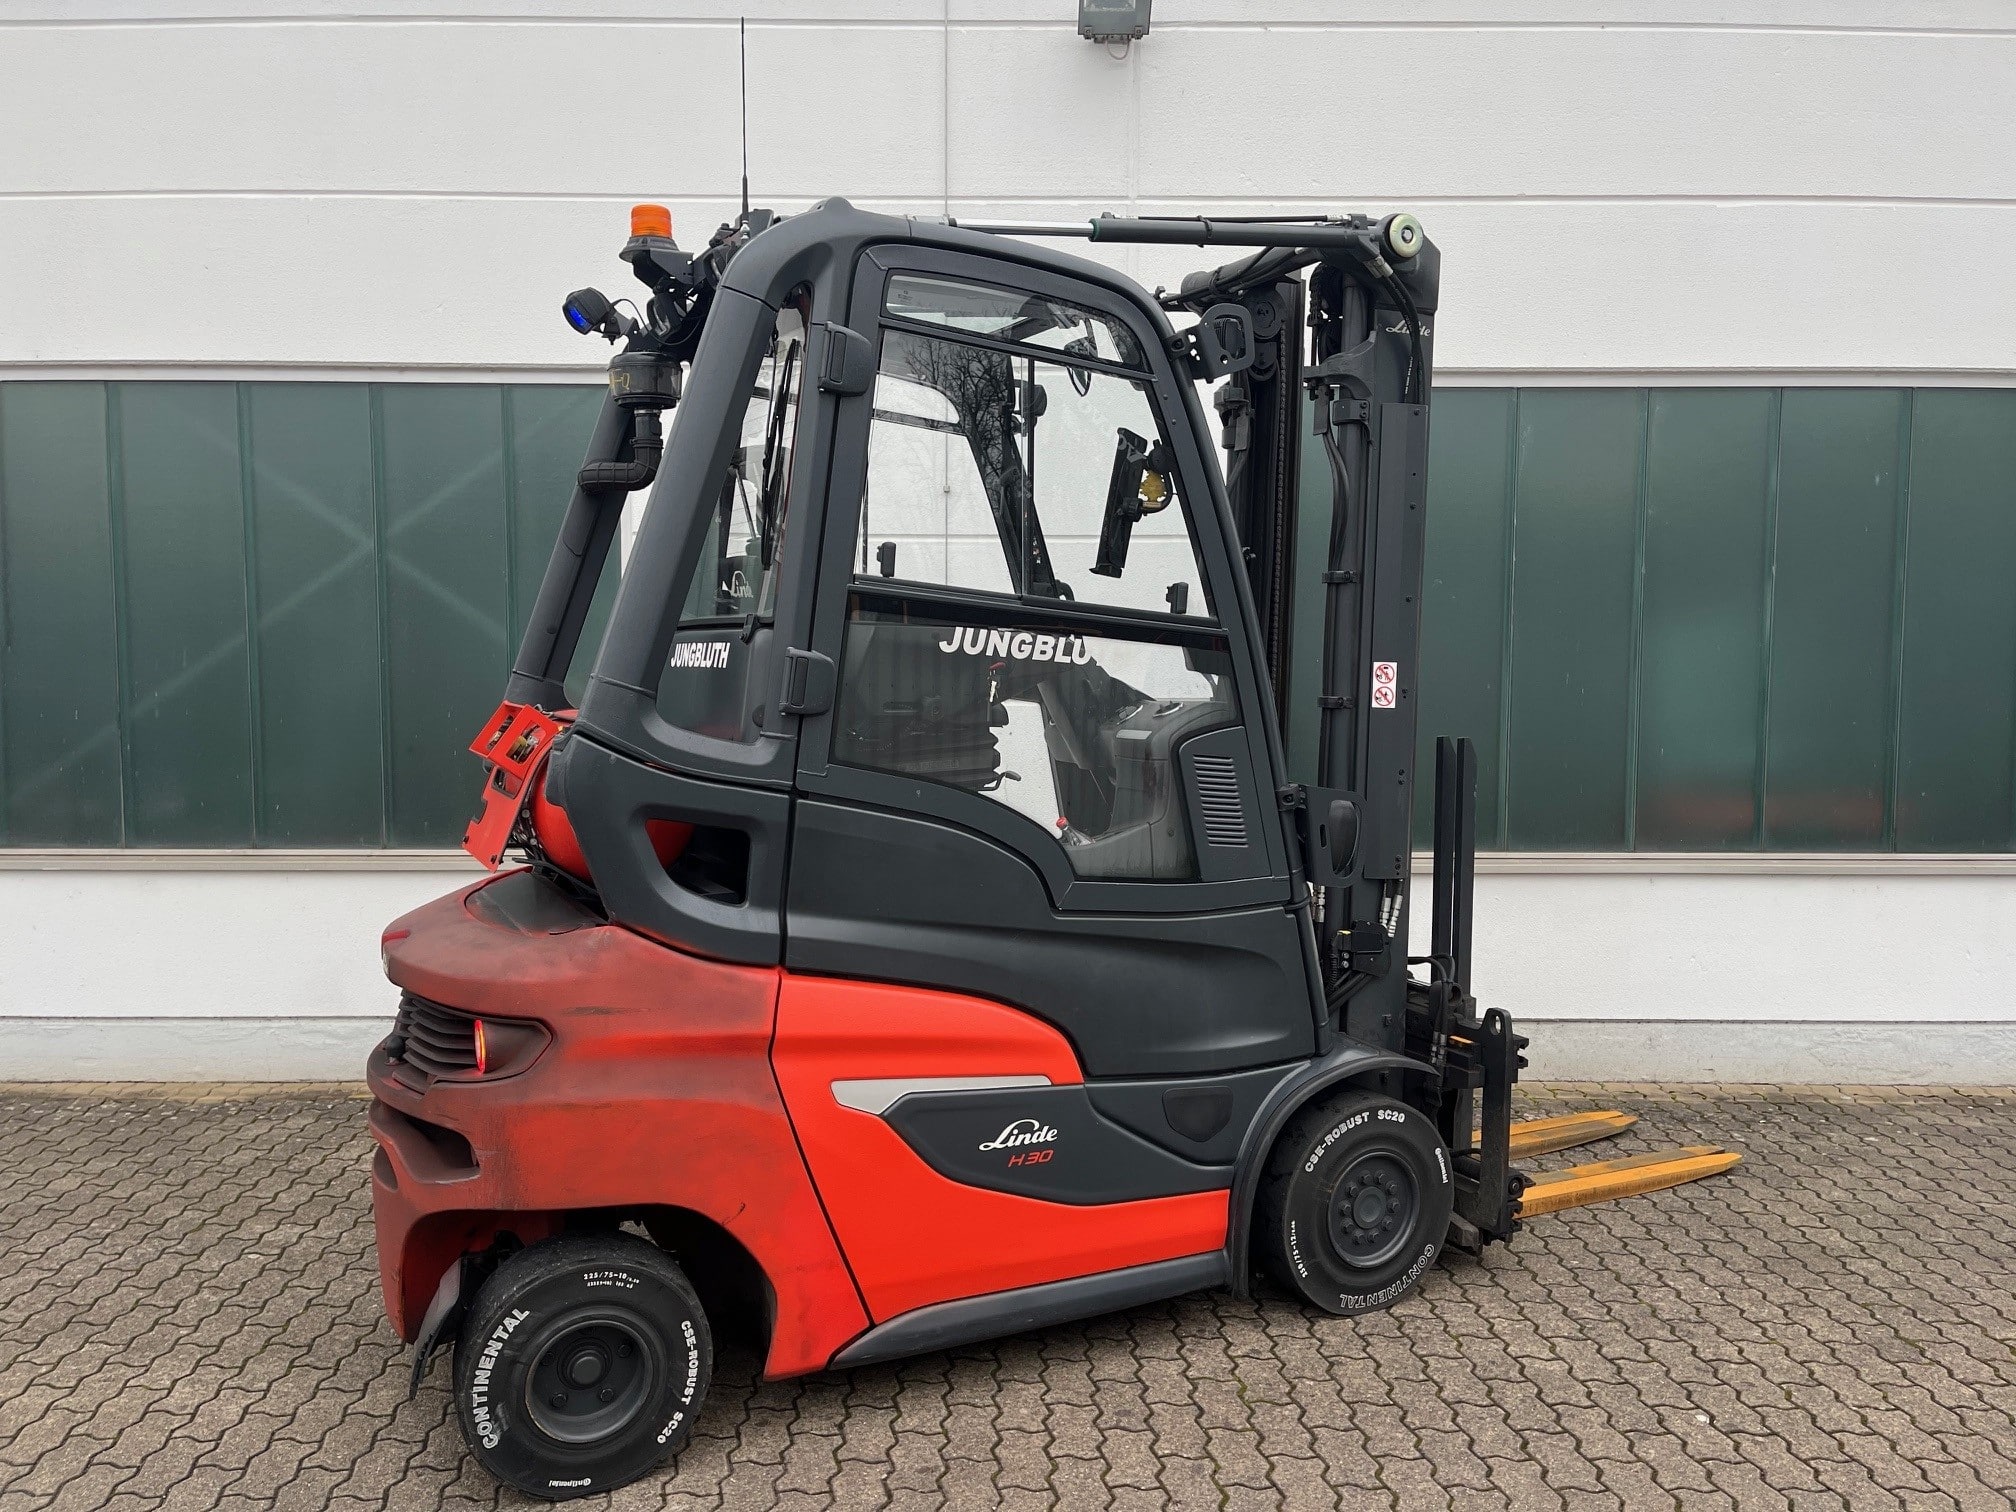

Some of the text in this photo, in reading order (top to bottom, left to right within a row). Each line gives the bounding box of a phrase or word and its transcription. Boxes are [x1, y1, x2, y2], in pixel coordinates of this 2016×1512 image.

[670, 642, 731, 670] JUNGBLUTH
[938, 626, 1093, 666] JUNGBLU
[978, 1119, 1058, 1151] Linde
[1007, 1150, 1054, 1168] H30
[1304, 1109, 1406, 1173] CSE-ROBUST SC20
[1339, 1244, 1435, 1309] CONTINENTAL
[472, 1308, 531, 1449] CONTINENTAL
[657, 1320, 699, 1444] CSE-ROBUST SC20
